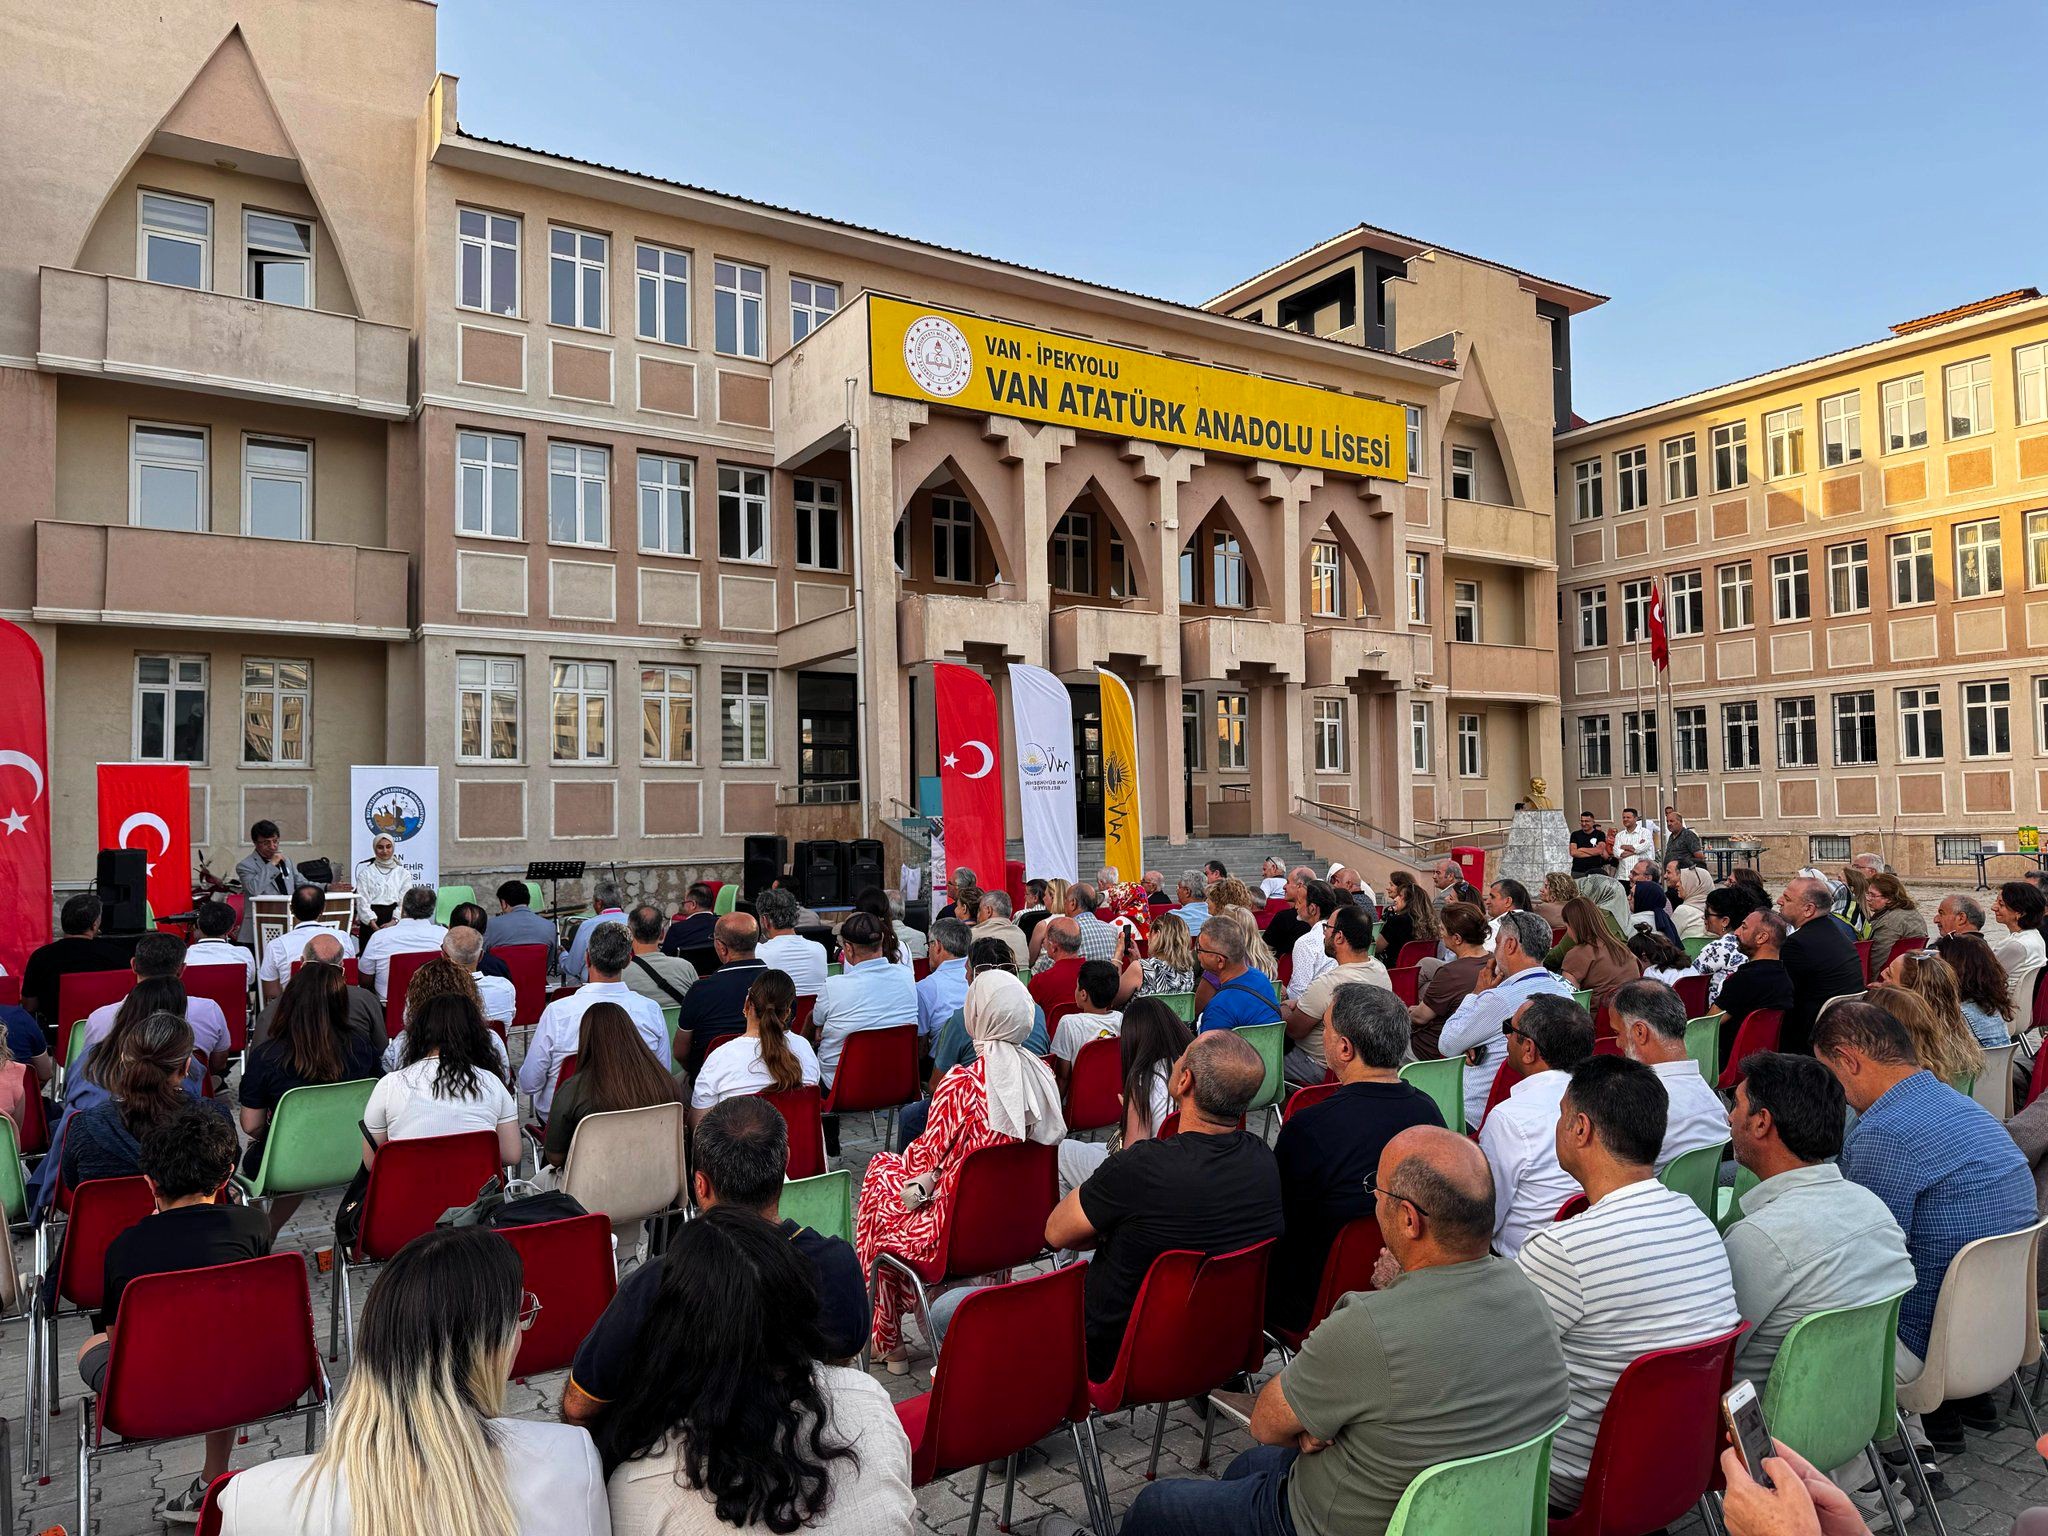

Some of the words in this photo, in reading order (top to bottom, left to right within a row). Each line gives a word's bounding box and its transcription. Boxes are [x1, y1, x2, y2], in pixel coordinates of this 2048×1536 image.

[985, 335, 1021, 361] VAN
[1037, 341, 1119, 380] İPEKYOLU
[985, 366, 1048, 410] VAN
[1058, 381, 1188, 435] ATATÜRK
[1194, 407, 1313, 455] ANADOLU
[1321, 424, 1390, 469] LİSESİ
